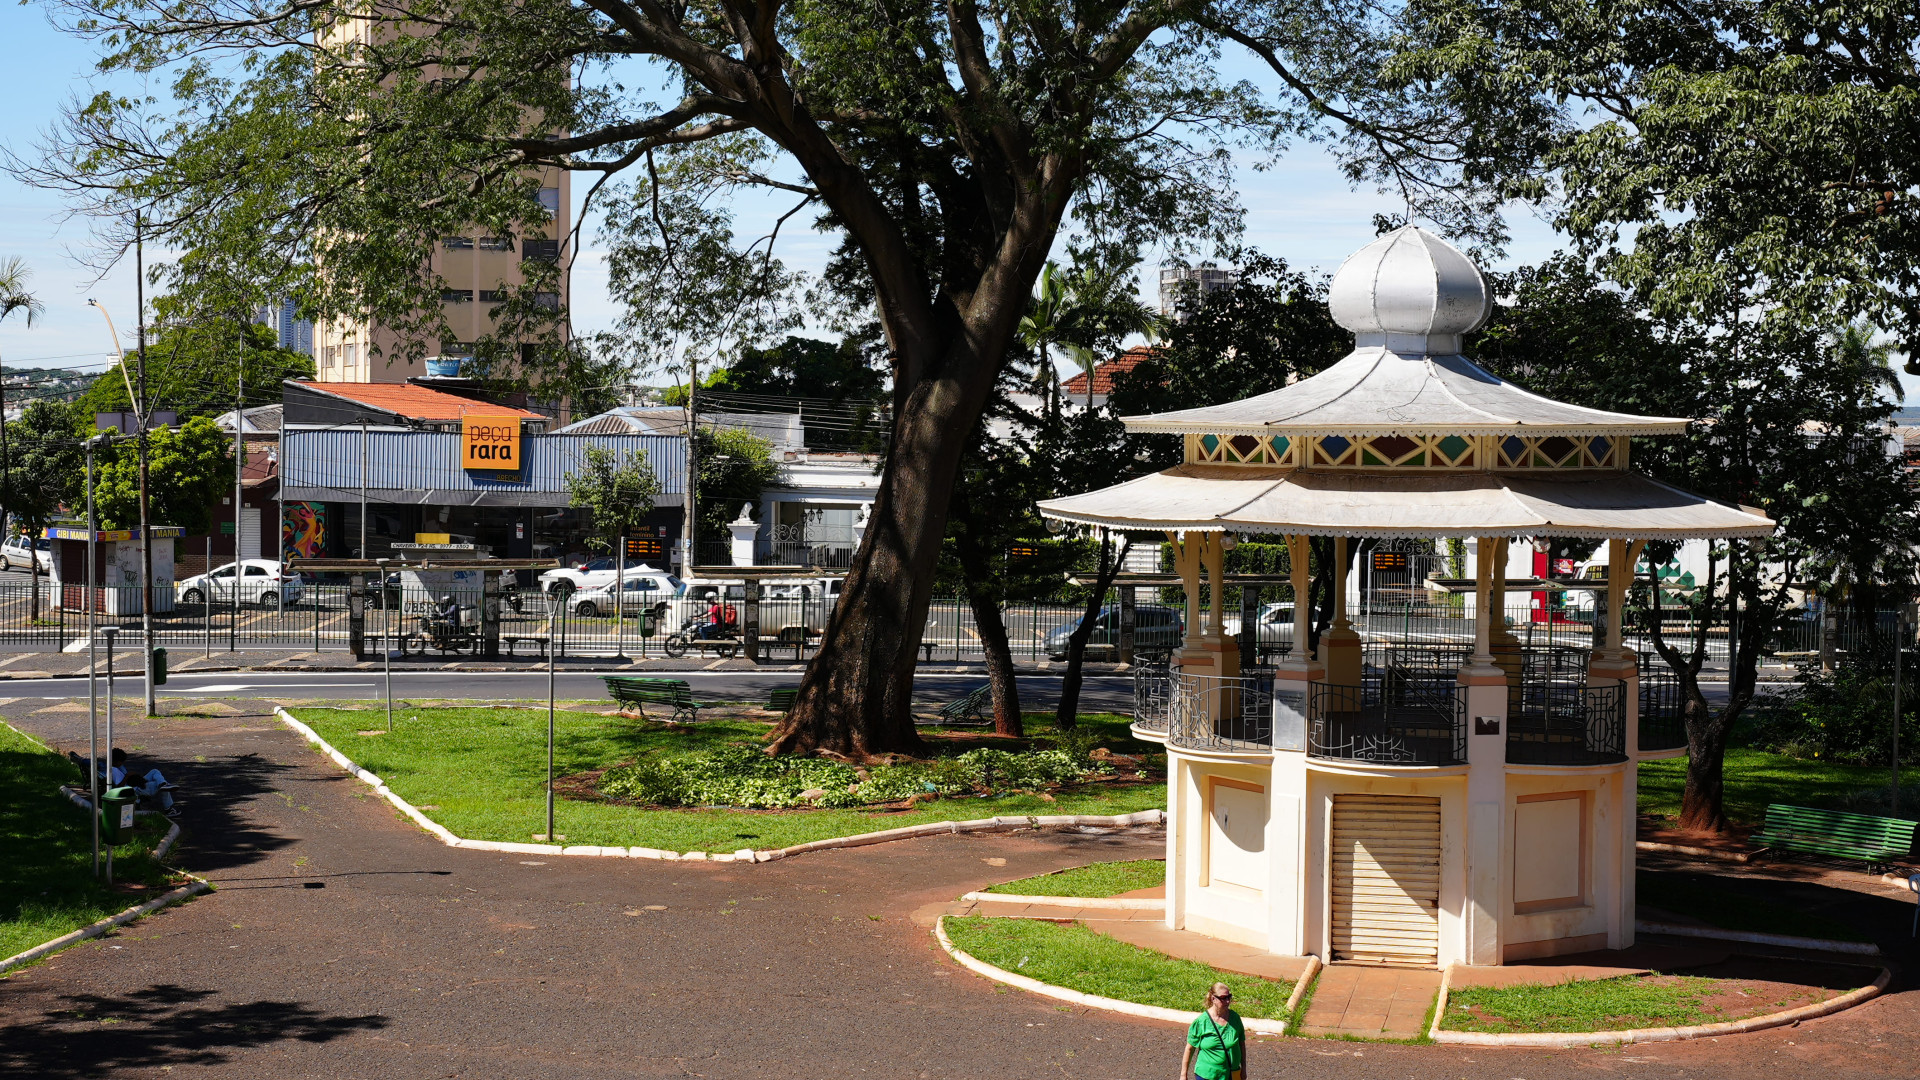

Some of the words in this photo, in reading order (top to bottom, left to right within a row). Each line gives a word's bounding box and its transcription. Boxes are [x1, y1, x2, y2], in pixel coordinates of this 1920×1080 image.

[470, 425, 512, 443] peça
[470, 444, 512, 460] rara
[56, 529, 69, 539] GIBI
[70, 530, 89, 540] MANIA
[156, 528, 180, 538] MANIA
